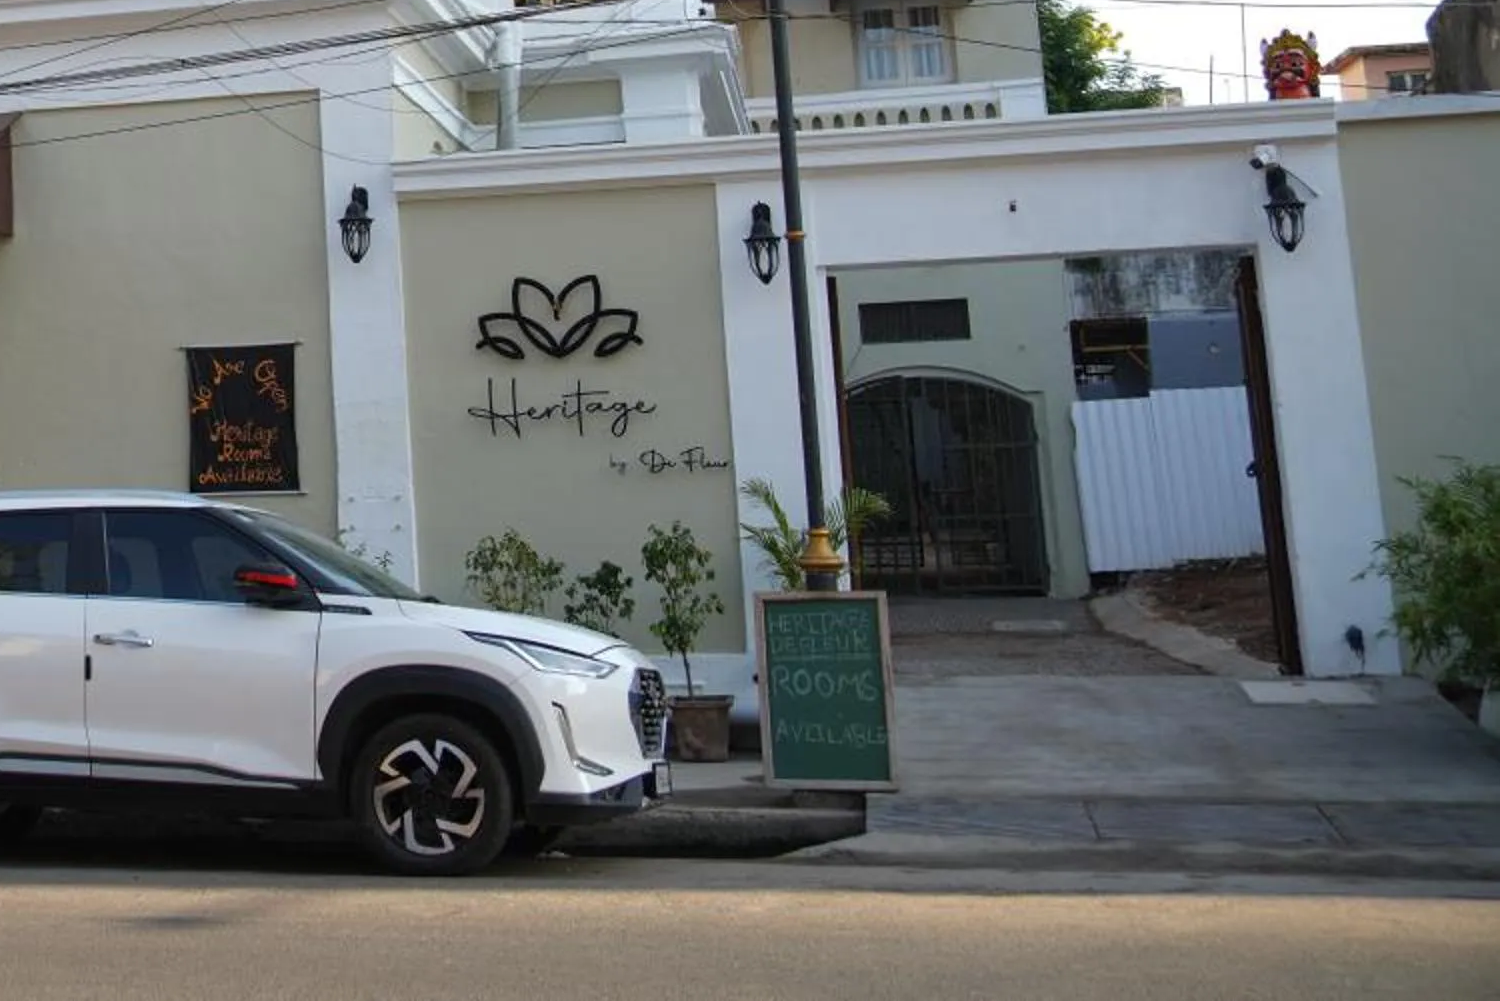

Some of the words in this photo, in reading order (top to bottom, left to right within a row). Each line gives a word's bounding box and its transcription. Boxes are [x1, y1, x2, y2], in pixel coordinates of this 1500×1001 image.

[468, 377, 657, 438] Heritage
[608, 452, 627, 476] by
[767, 608, 870, 635] HERITAGE
[771, 664, 879, 702] ROOMS
